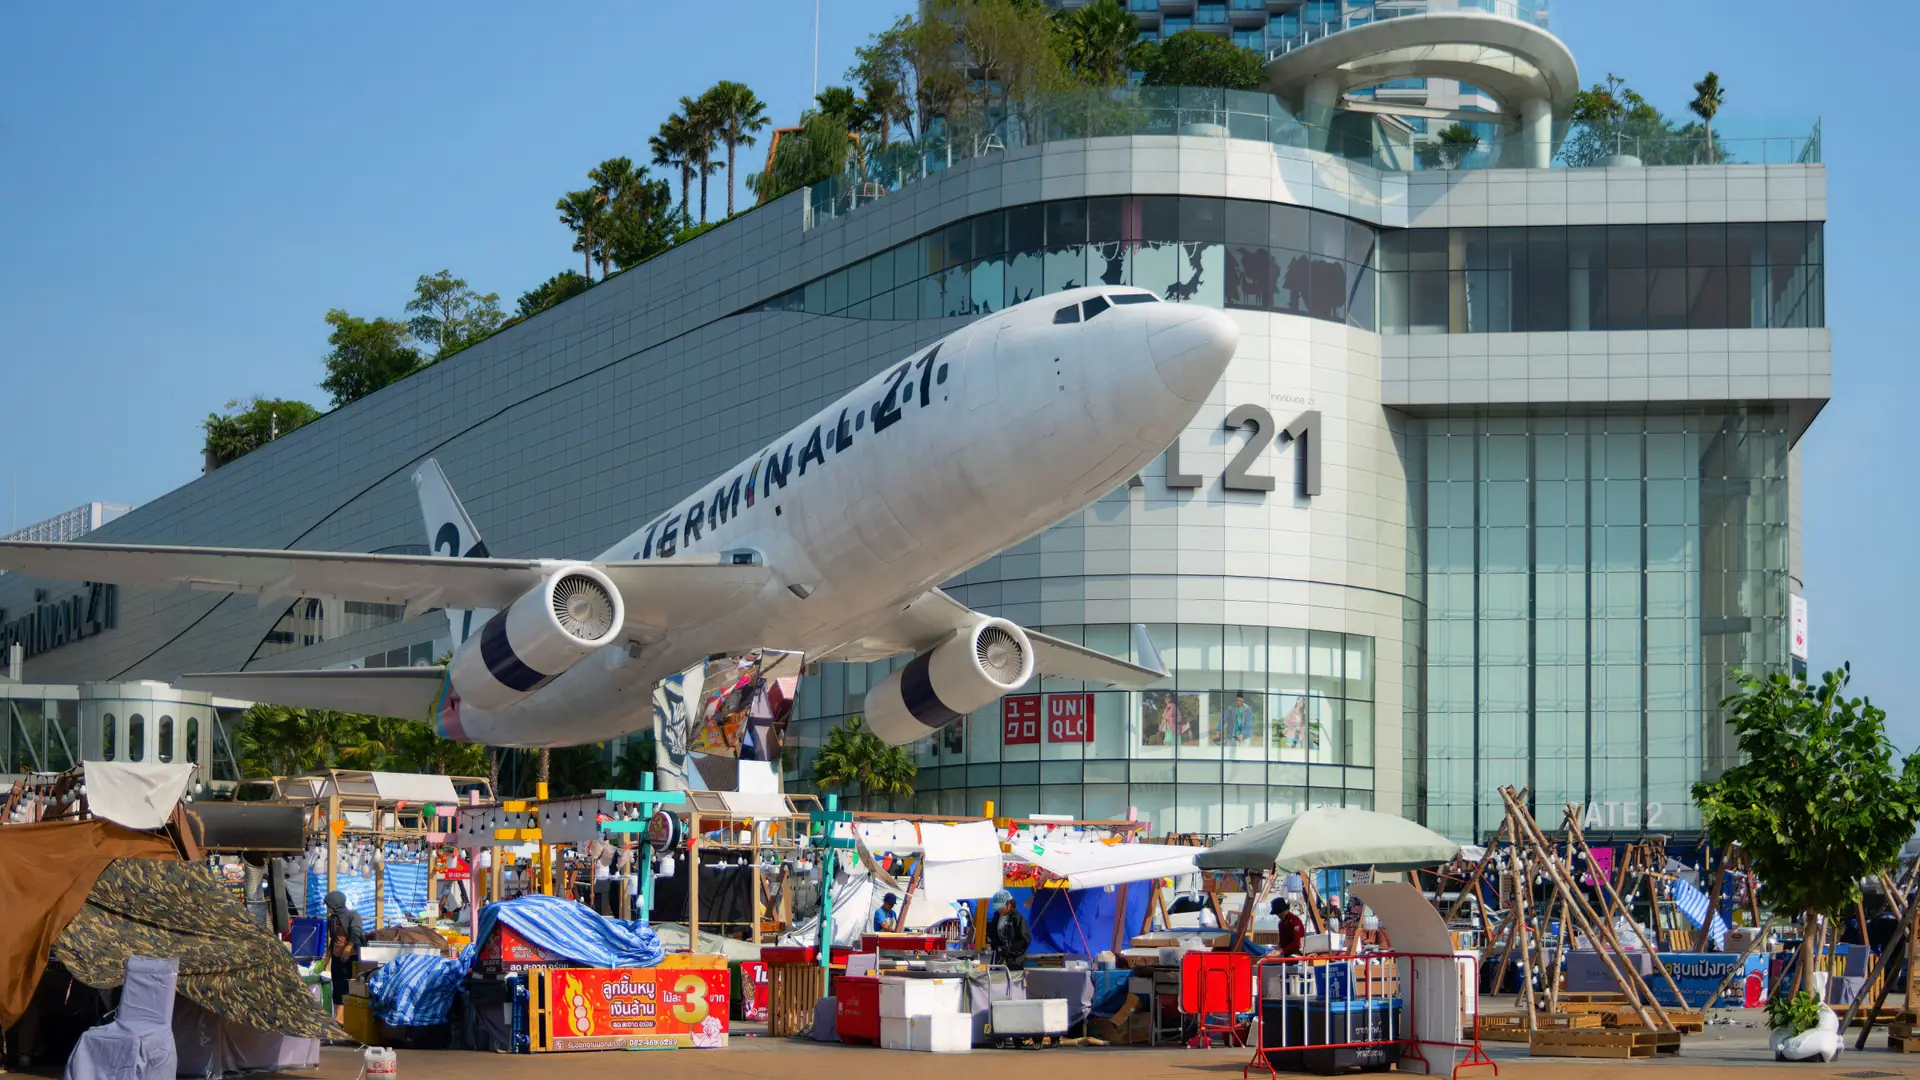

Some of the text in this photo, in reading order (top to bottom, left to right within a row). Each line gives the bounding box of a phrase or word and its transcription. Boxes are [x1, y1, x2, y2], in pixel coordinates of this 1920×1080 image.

[642, 342, 945, 560] TERMINAL 21
[1225, 403, 1322, 496] 21
[1052, 699, 1084, 717] UNI
[1052, 719, 1088, 739] QLO
[1646, 801, 1663, 828] 2
[1653, 959, 1745, 981] ชุบแป้งทอด
[602, 974, 656, 1000] ลูกชิ้นหมู
[662, 990, 682, 1003] ไม้ละ
[709, 994, 725, 1002] บาท
[610, 999, 656, 1016] เงินล้าน
[672, 974, 710, 1024] 3
